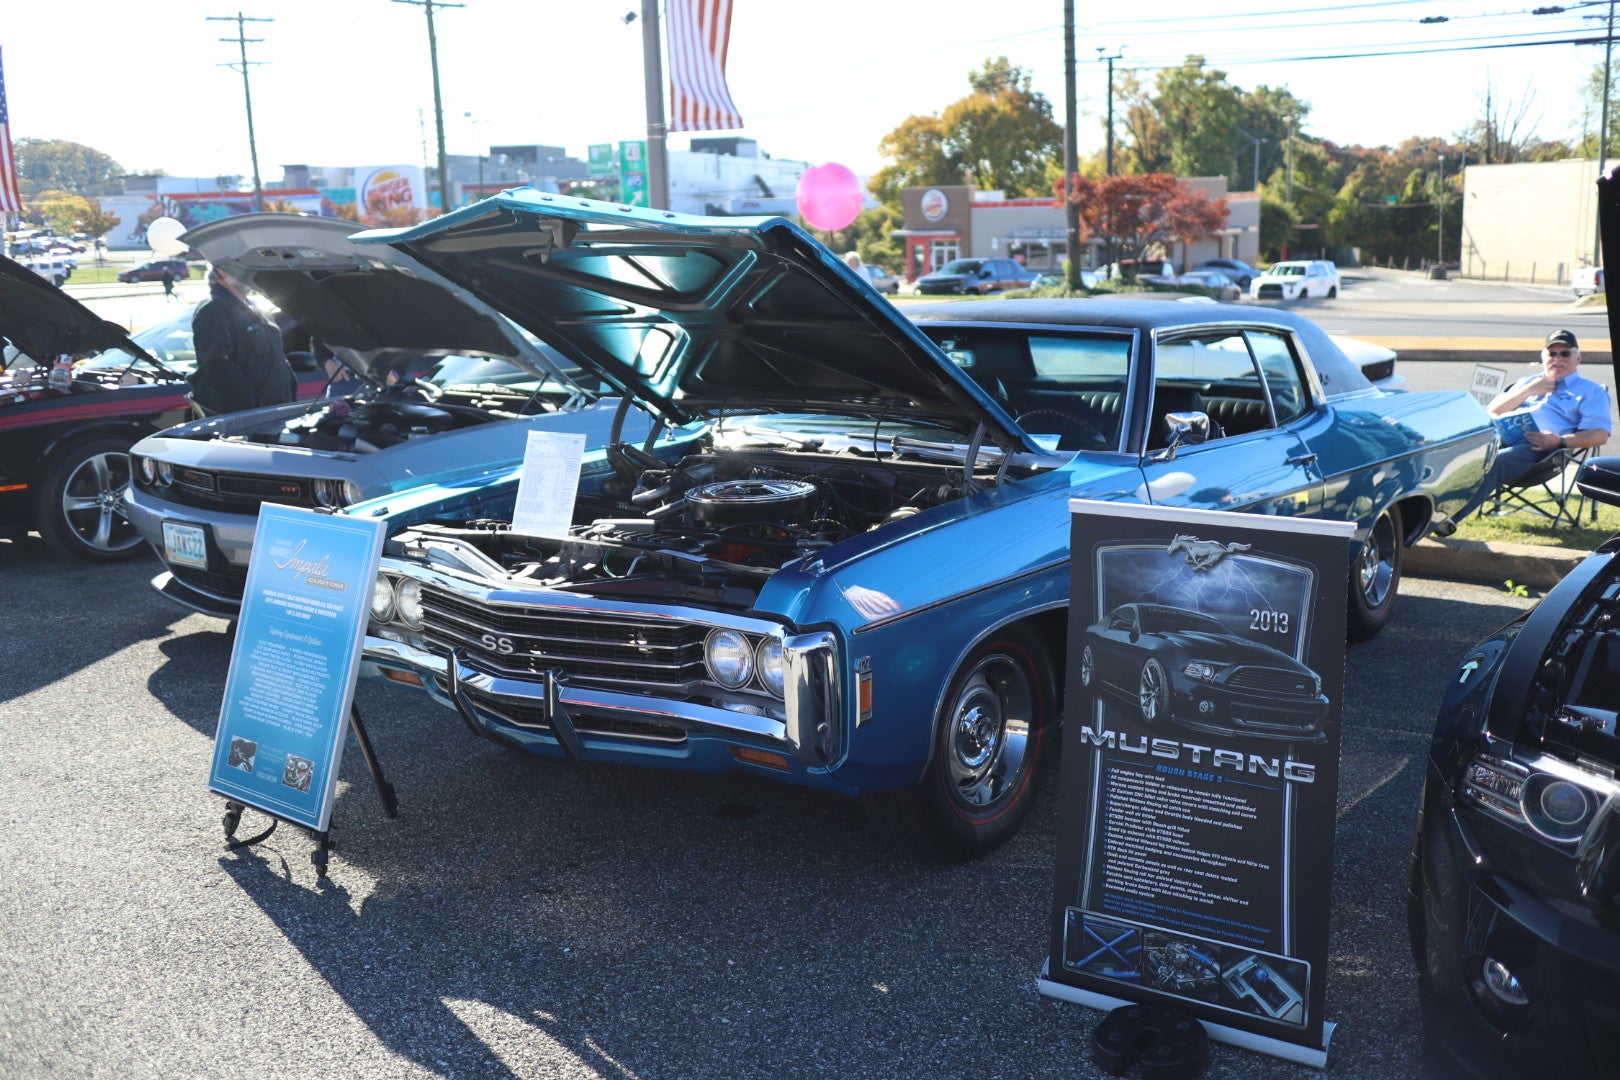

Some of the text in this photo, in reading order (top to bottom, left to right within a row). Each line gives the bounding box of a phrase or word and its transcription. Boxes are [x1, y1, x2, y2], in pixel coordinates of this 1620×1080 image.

[274, 538, 330, 580] Impala
[307, 577, 345, 590] CUSTOM
[1249, 609, 1289, 634] 2013
[481, 634, 514, 655] SS
[1080, 725, 1316, 784] MUSTANG
[1156, 764, 1184, 777] ROUSH
[1185, 769, 1216, 782] STAGE
